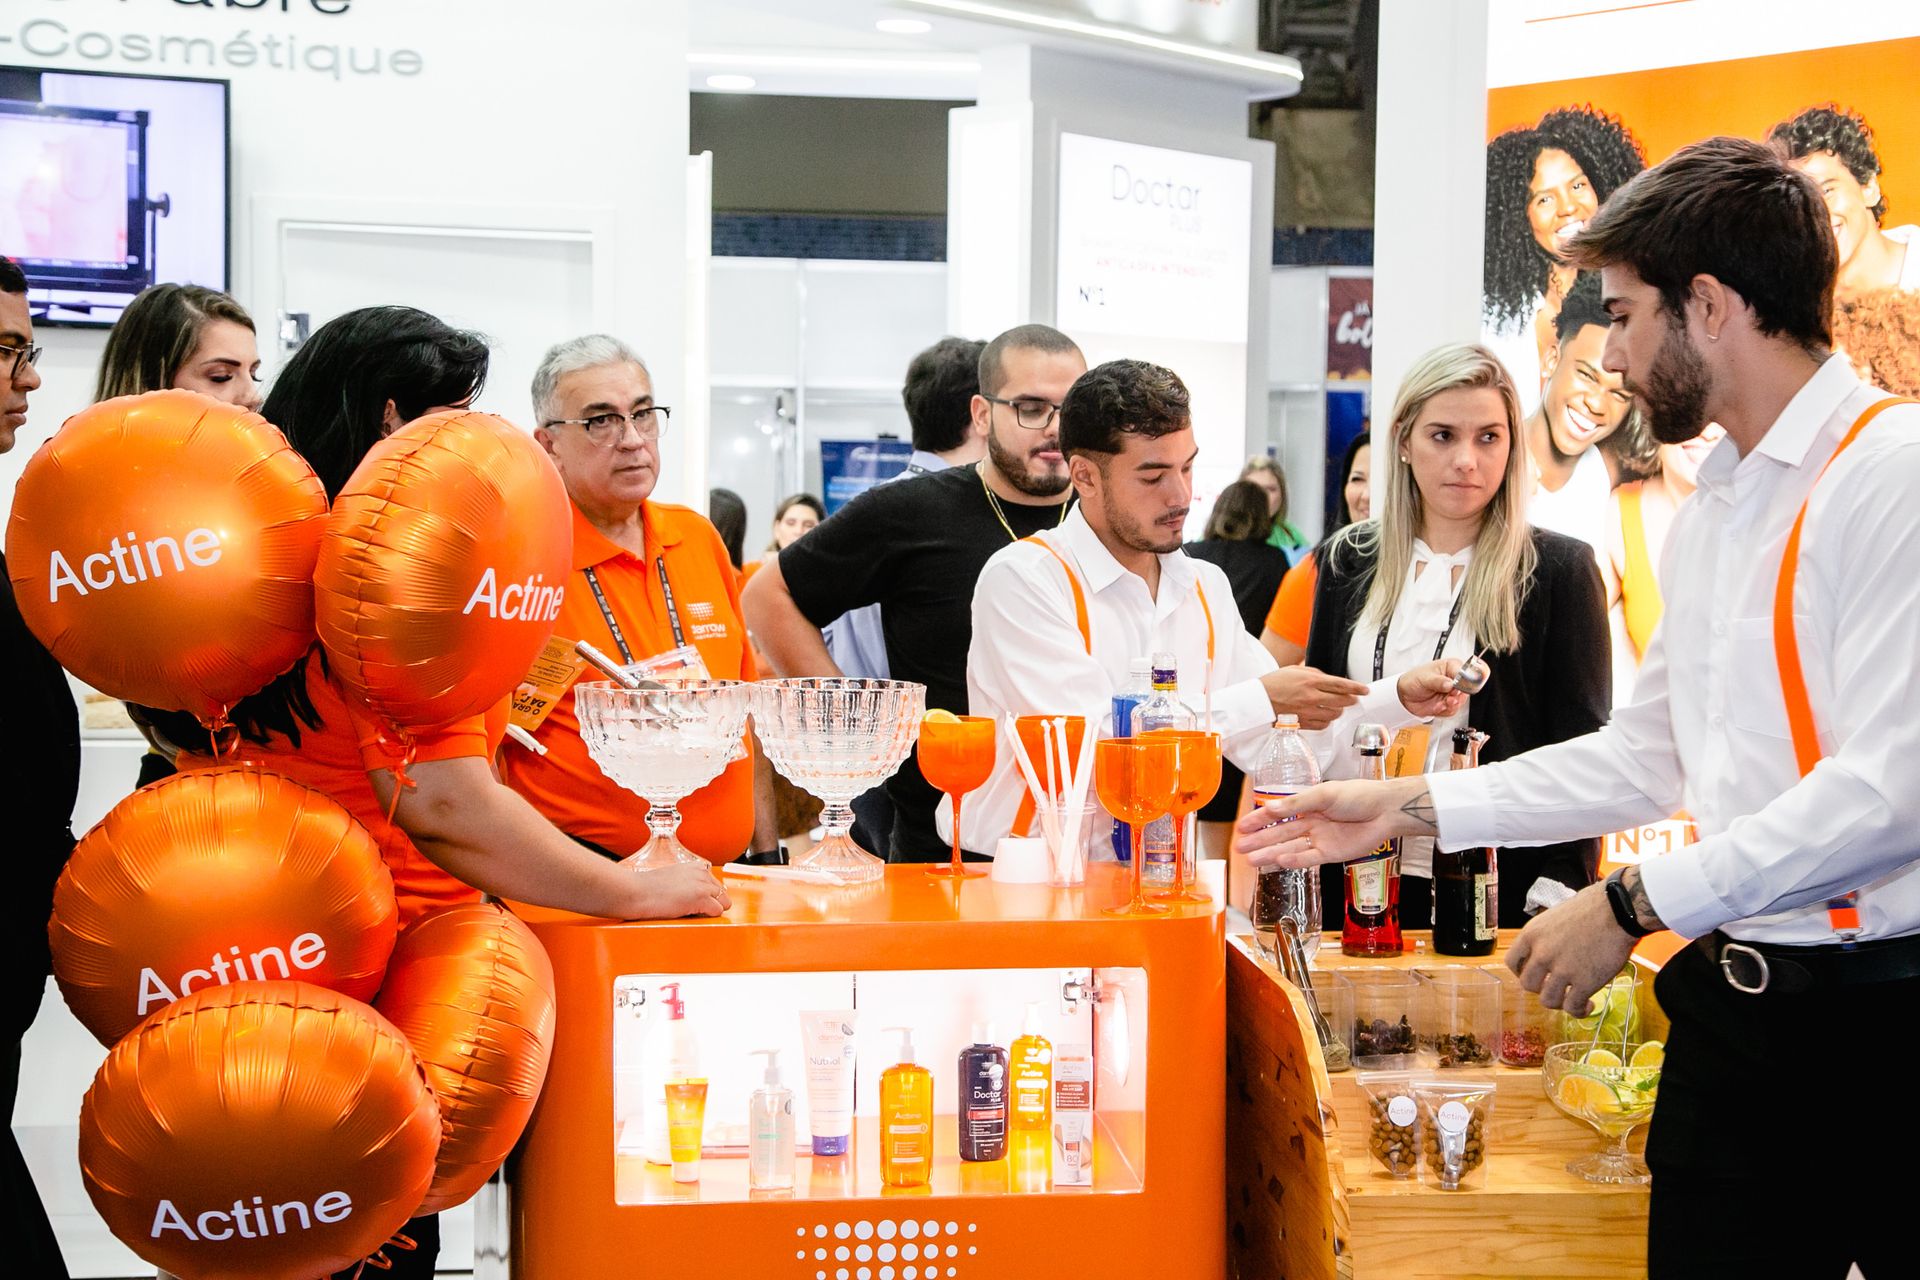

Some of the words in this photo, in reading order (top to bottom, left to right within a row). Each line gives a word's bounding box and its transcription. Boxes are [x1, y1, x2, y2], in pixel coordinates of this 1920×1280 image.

[50, 528, 222, 603] Actine
[462, 567, 564, 621] Actine
[137, 932, 327, 1016] Actine
[150, 1190, 353, 1241] Actine
